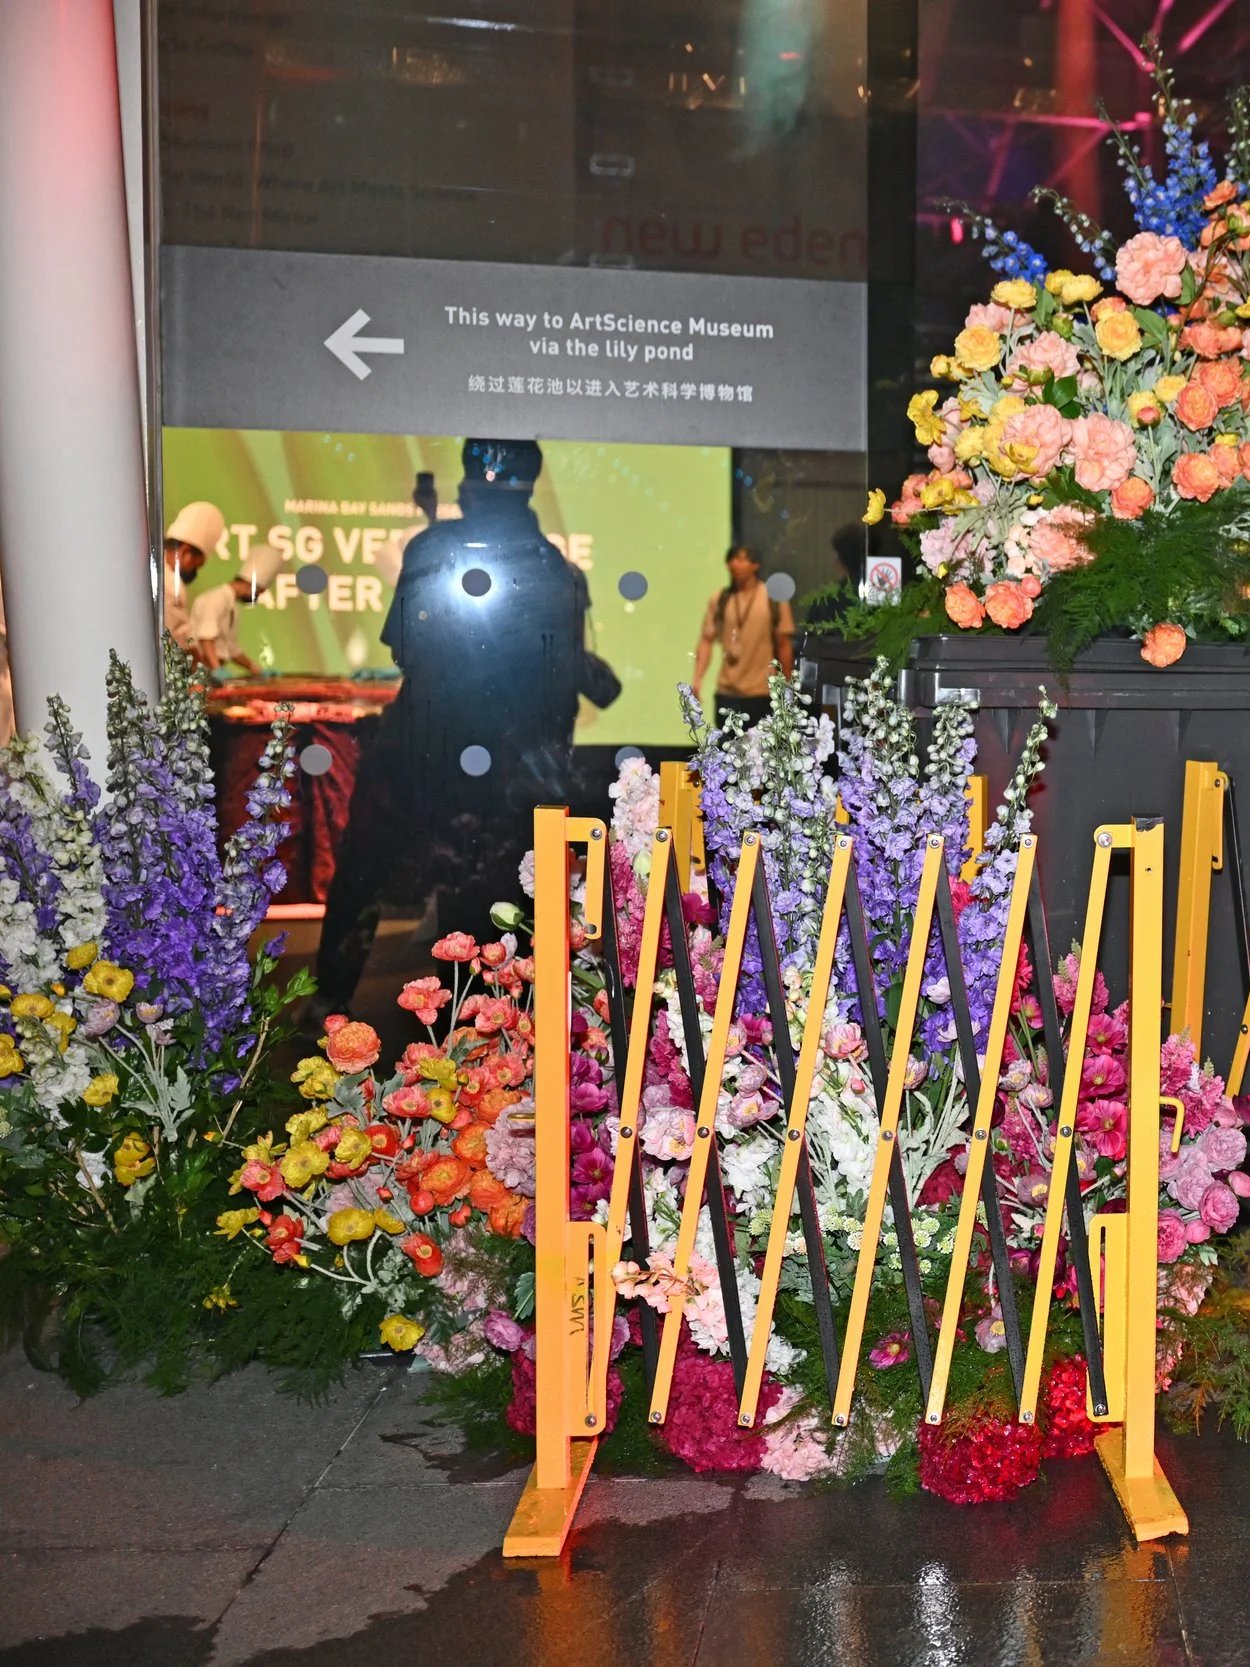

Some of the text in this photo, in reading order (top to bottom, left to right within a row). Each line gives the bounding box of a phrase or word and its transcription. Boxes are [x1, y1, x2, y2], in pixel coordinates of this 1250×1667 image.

[603, 215, 867, 266] new eden
[445, 306, 774, 338] This way to ArtScience Museum
[530, 337, 694, 363] via the lily pond
[468, 374, 753, 402] 绕过莲花池以进入艺术科学博物馆
[284, 499, 339, 515] MARINA
[341, 500, 366, 516] BAY
[369, 501, 414, 518] SANDS
[215, 524, 257, 561] RT
[268, 525, 324, 563] SG
